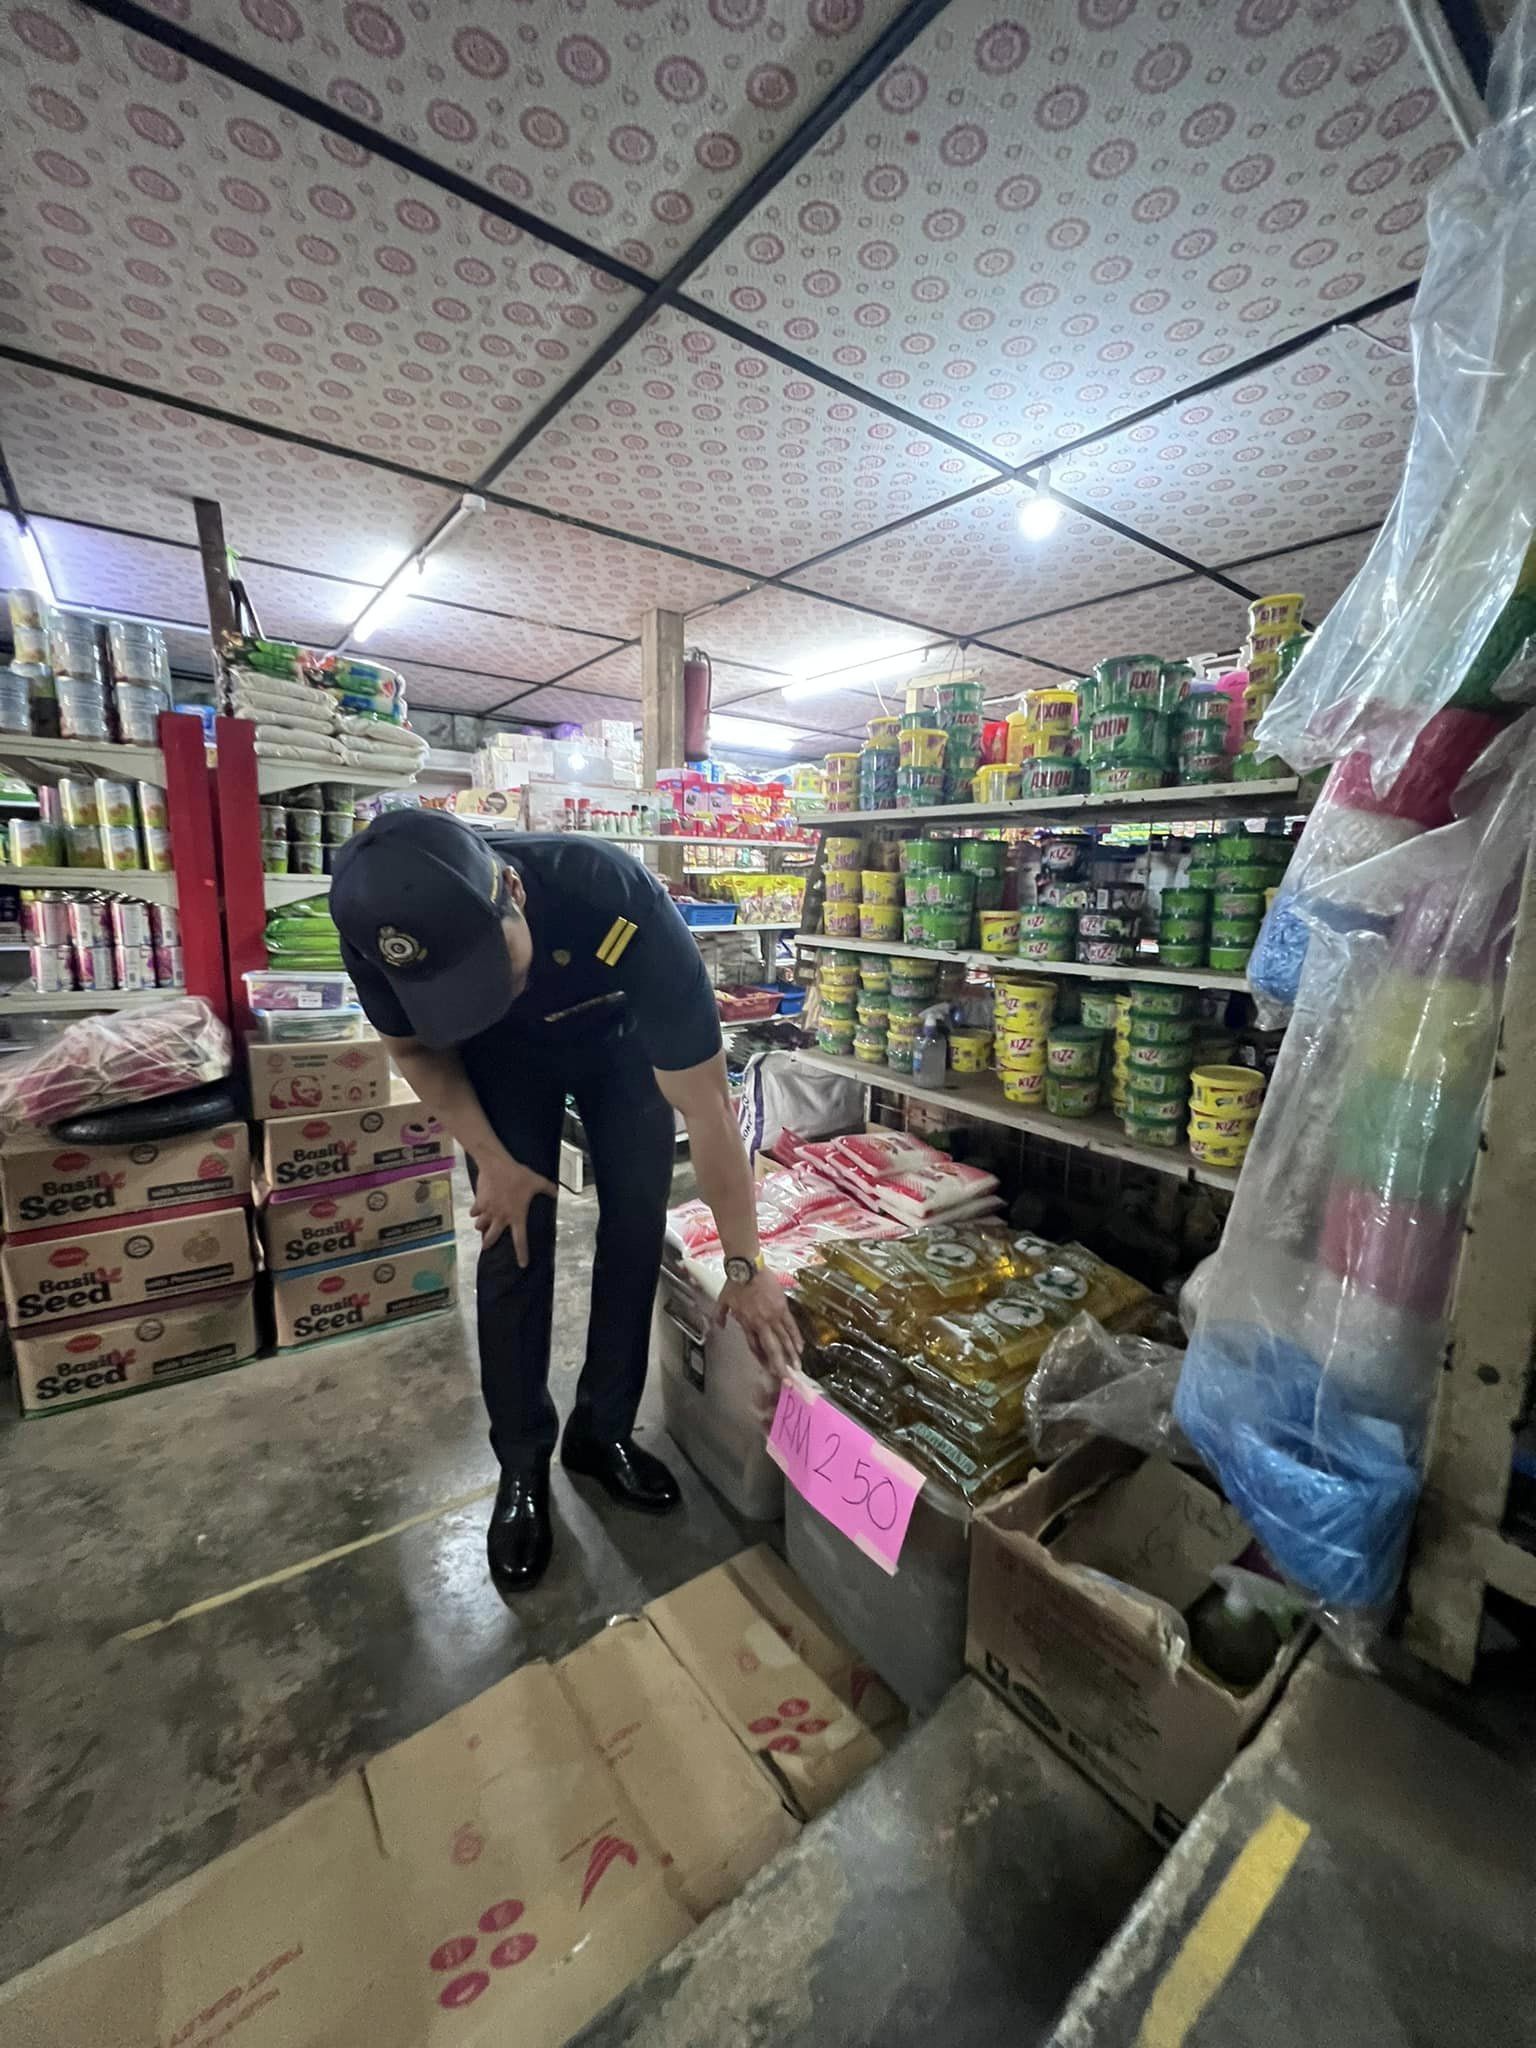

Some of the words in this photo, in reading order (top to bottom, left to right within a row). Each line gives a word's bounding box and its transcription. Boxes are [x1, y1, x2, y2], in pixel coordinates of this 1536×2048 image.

[1031, 769, 1072, 788] AXION
[1010, 1038, 1034, 1051] KIZZ
[1215, 1120, 1241, 1131] KIZZ
[294, 1141, 339, 1163] Basil
[276, 1153, 350, 1185] Seed
[42, 1174, 102, 1197] Basil
[19, 1186, 117, 1221] Seed
[301, 1220, 348, 1241] Basil
[285, 1231, 356, 1261] Seed
[39, 1271, 98, 1296] Basil
[17, 1281, 112, 1319] Seed
[310, 1295, 355, 1317] Basil
[293, 1305, 364, 1338] Seed
[57, 1350, 112, 1377] Basil
[36, 1361, 128, 1400] Seed
[778, 1393, 812, 1470] RM
[812, 1432, 841, 1484] 2
[841, 1457, 898, 1531] 50
